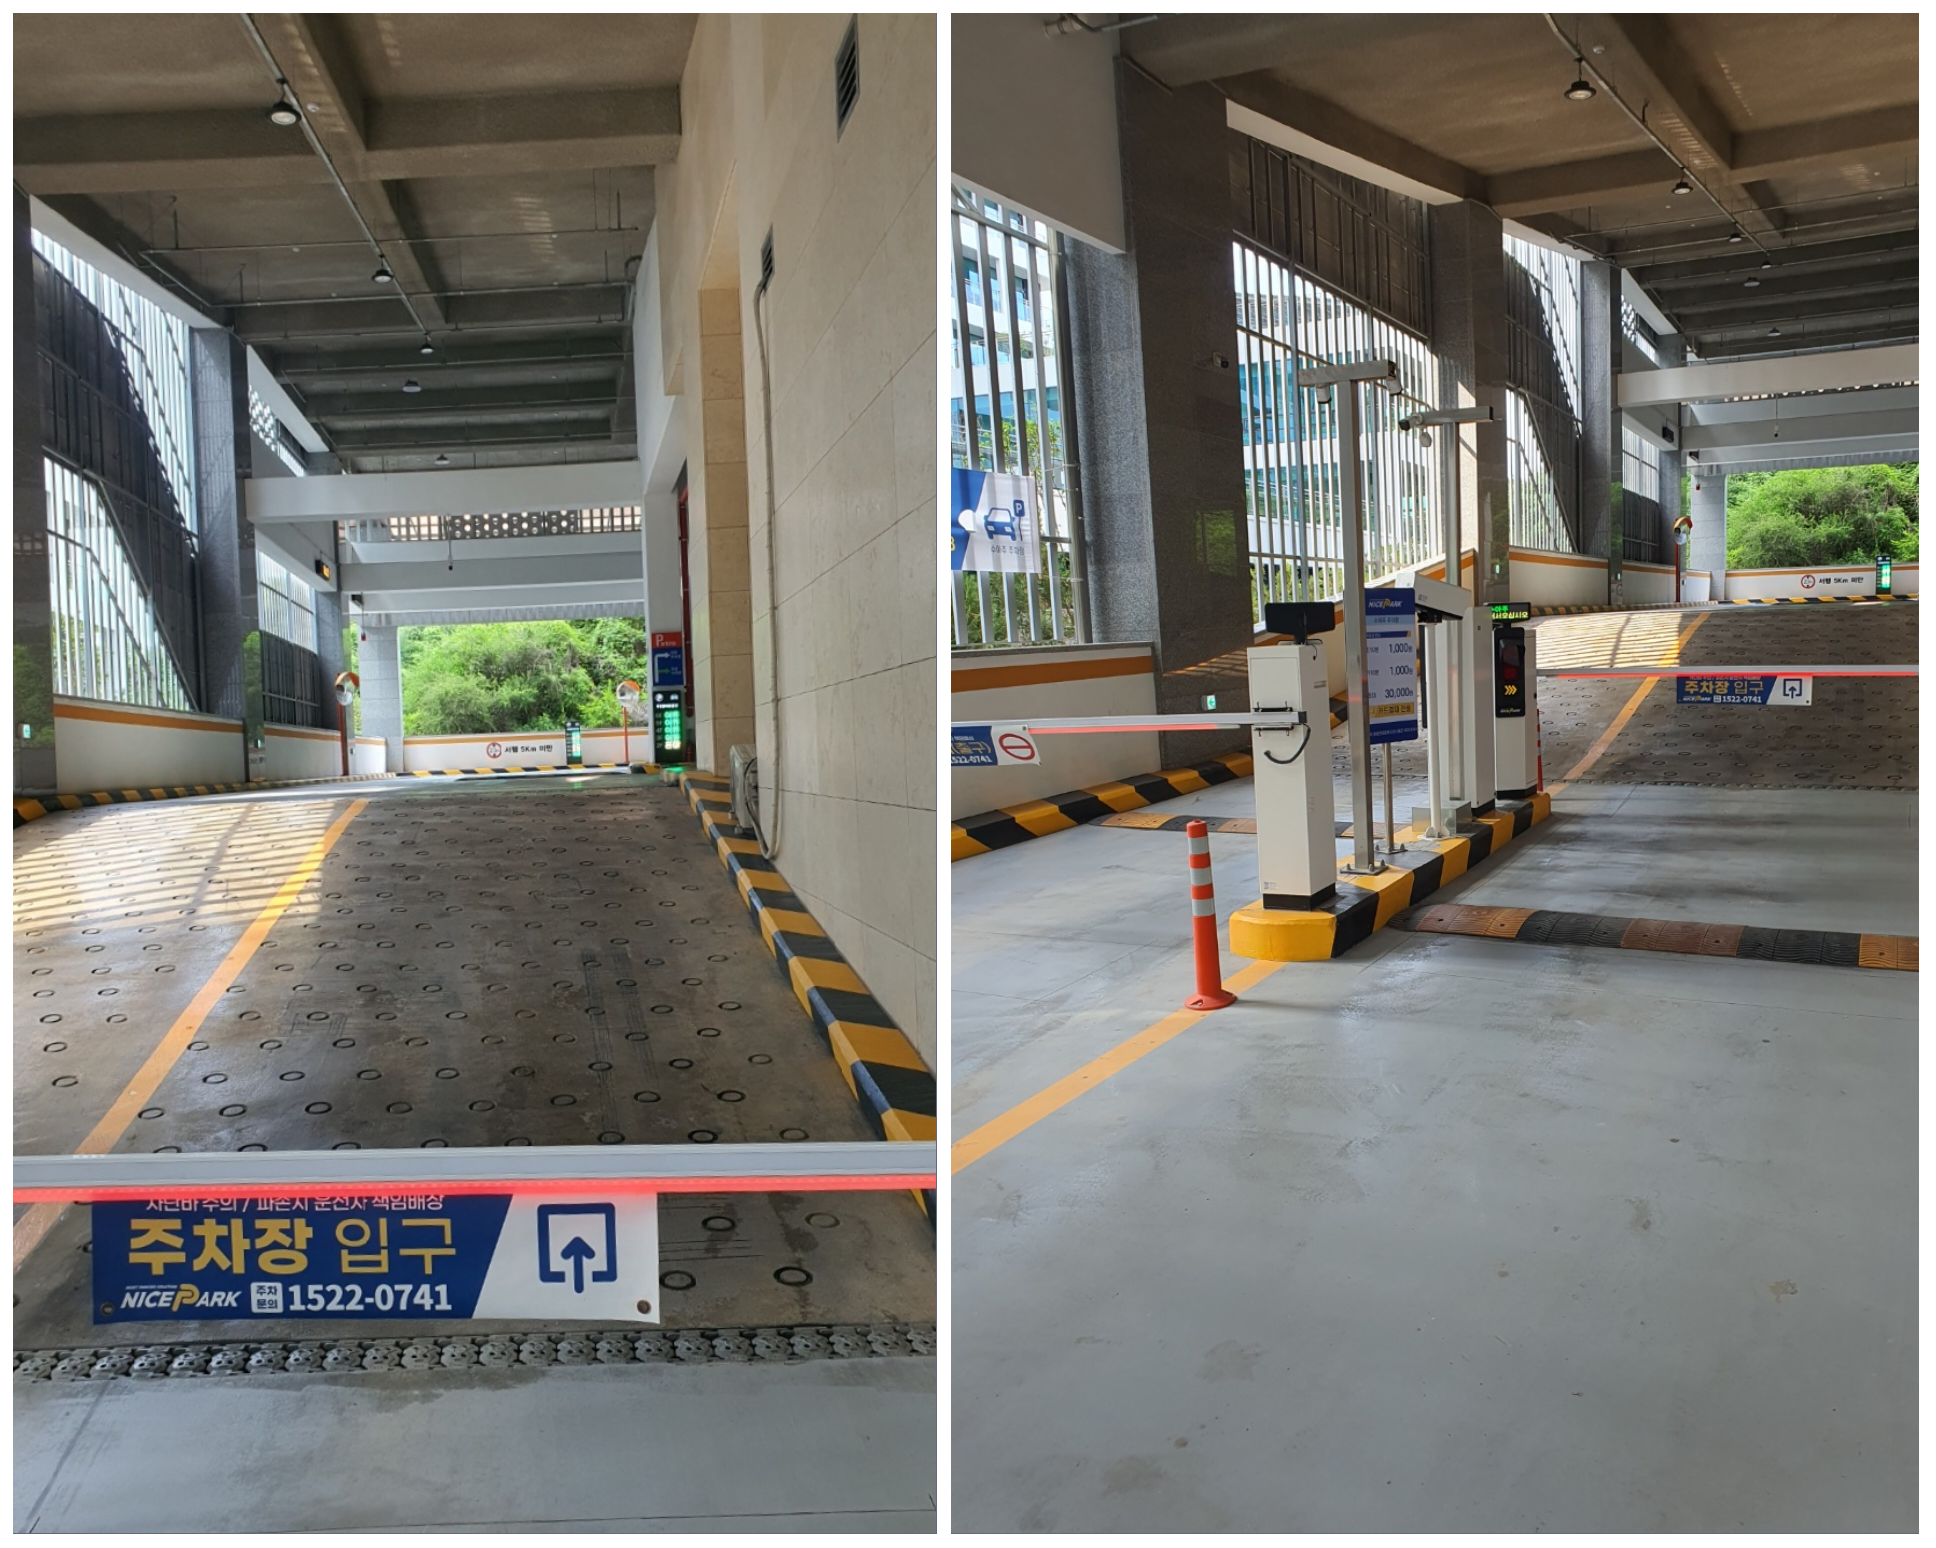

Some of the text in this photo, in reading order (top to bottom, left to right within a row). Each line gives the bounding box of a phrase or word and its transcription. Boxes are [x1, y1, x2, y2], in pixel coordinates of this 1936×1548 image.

[1850, 576, 1864, 584] 미만
[1684, 680, 1764, 695] 주차장 입구
[1722, 695, 1762, 703] 1522-0741
[504, 745, 519, 753] 서행
[520, 745, 537, 753] 5Km
[538, 744, 553, 752] 미만
[951, 756, 993, 764] 522-0741
[128, 1217, 457, 1276] 주차장 입구
[256, 1285, 278, 1297] 주차
[120, 1283, 243, 1313] NICEPARK
[288, 1283, 453, 1312] 1522-0741
[256, 1298, 279, 1310] 문의
